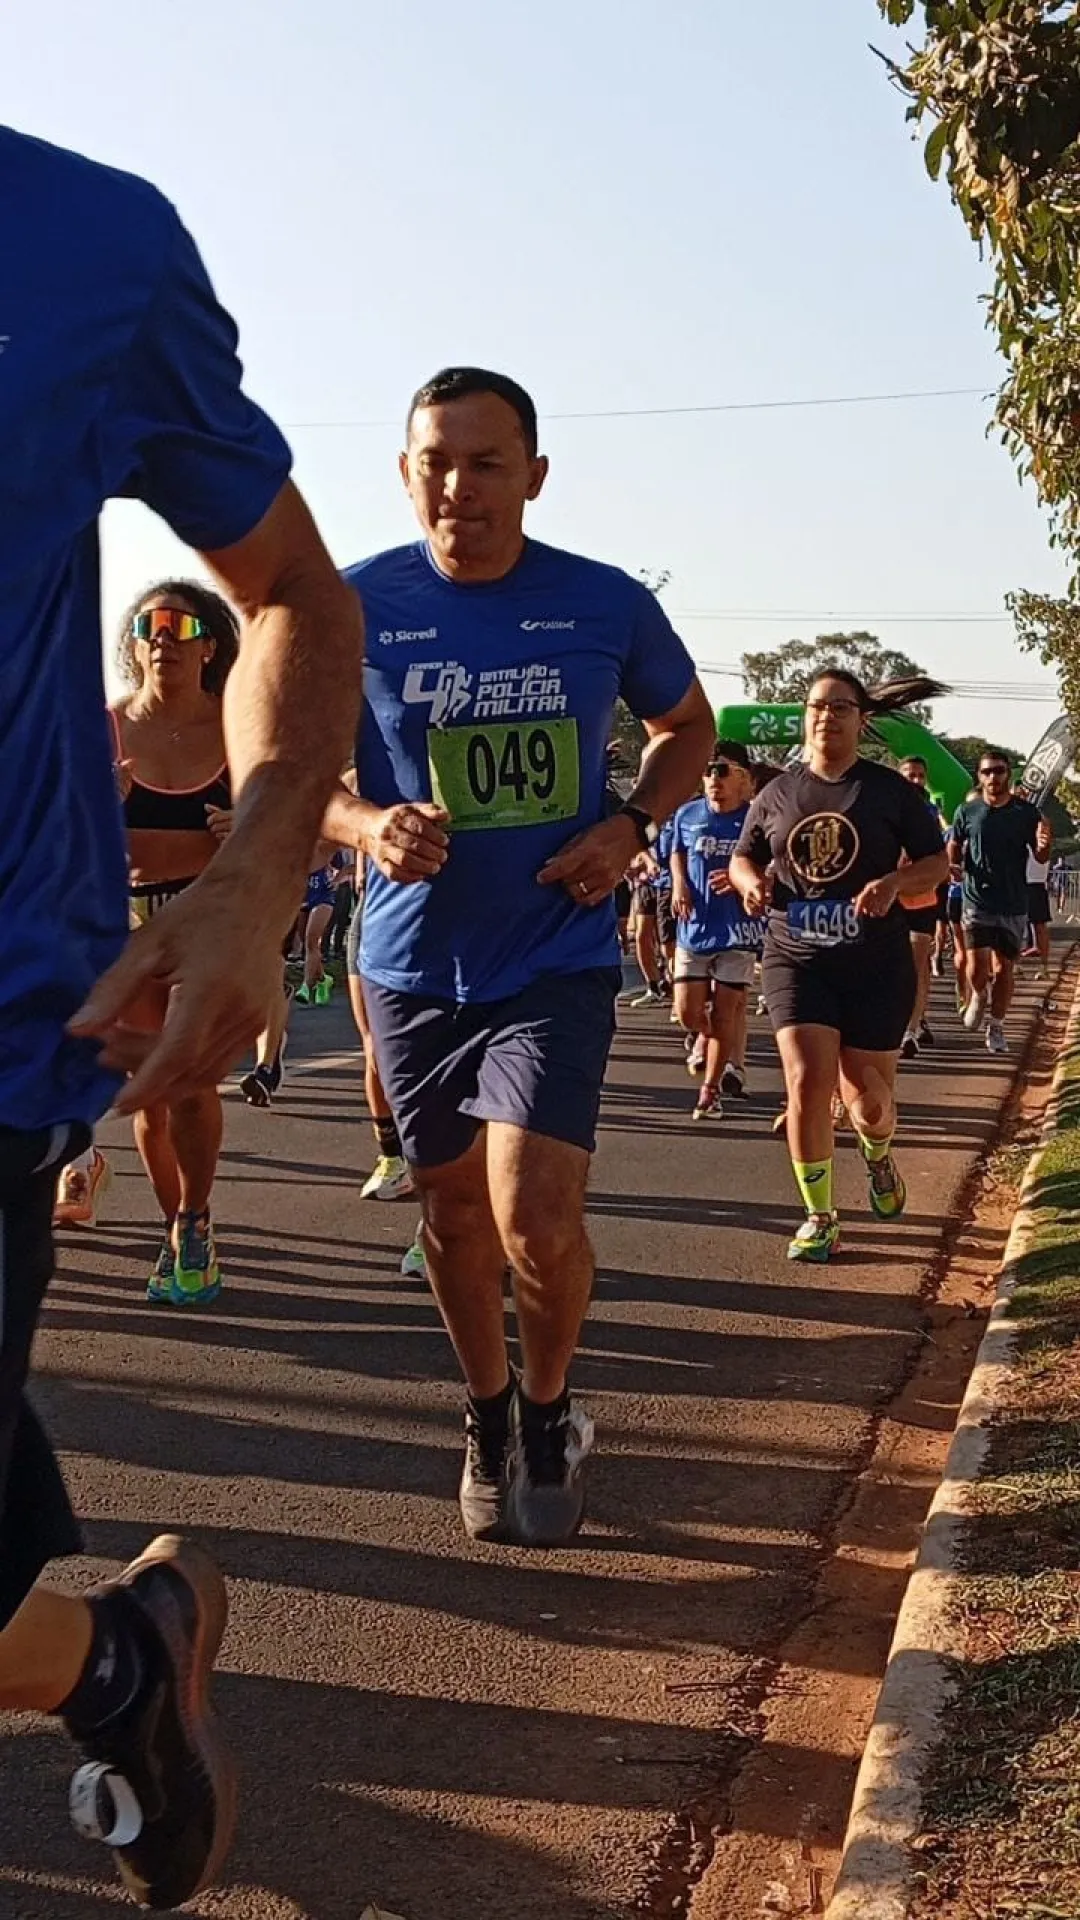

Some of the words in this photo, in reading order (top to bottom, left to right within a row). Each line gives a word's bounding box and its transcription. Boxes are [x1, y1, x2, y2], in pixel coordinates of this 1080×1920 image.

[395, 627, 438, 642] Sicredi
[474, 695, 567, 718] MILITAR
[467, 729, 556, 805] 049
[800, 902, 860, 941] 1648
